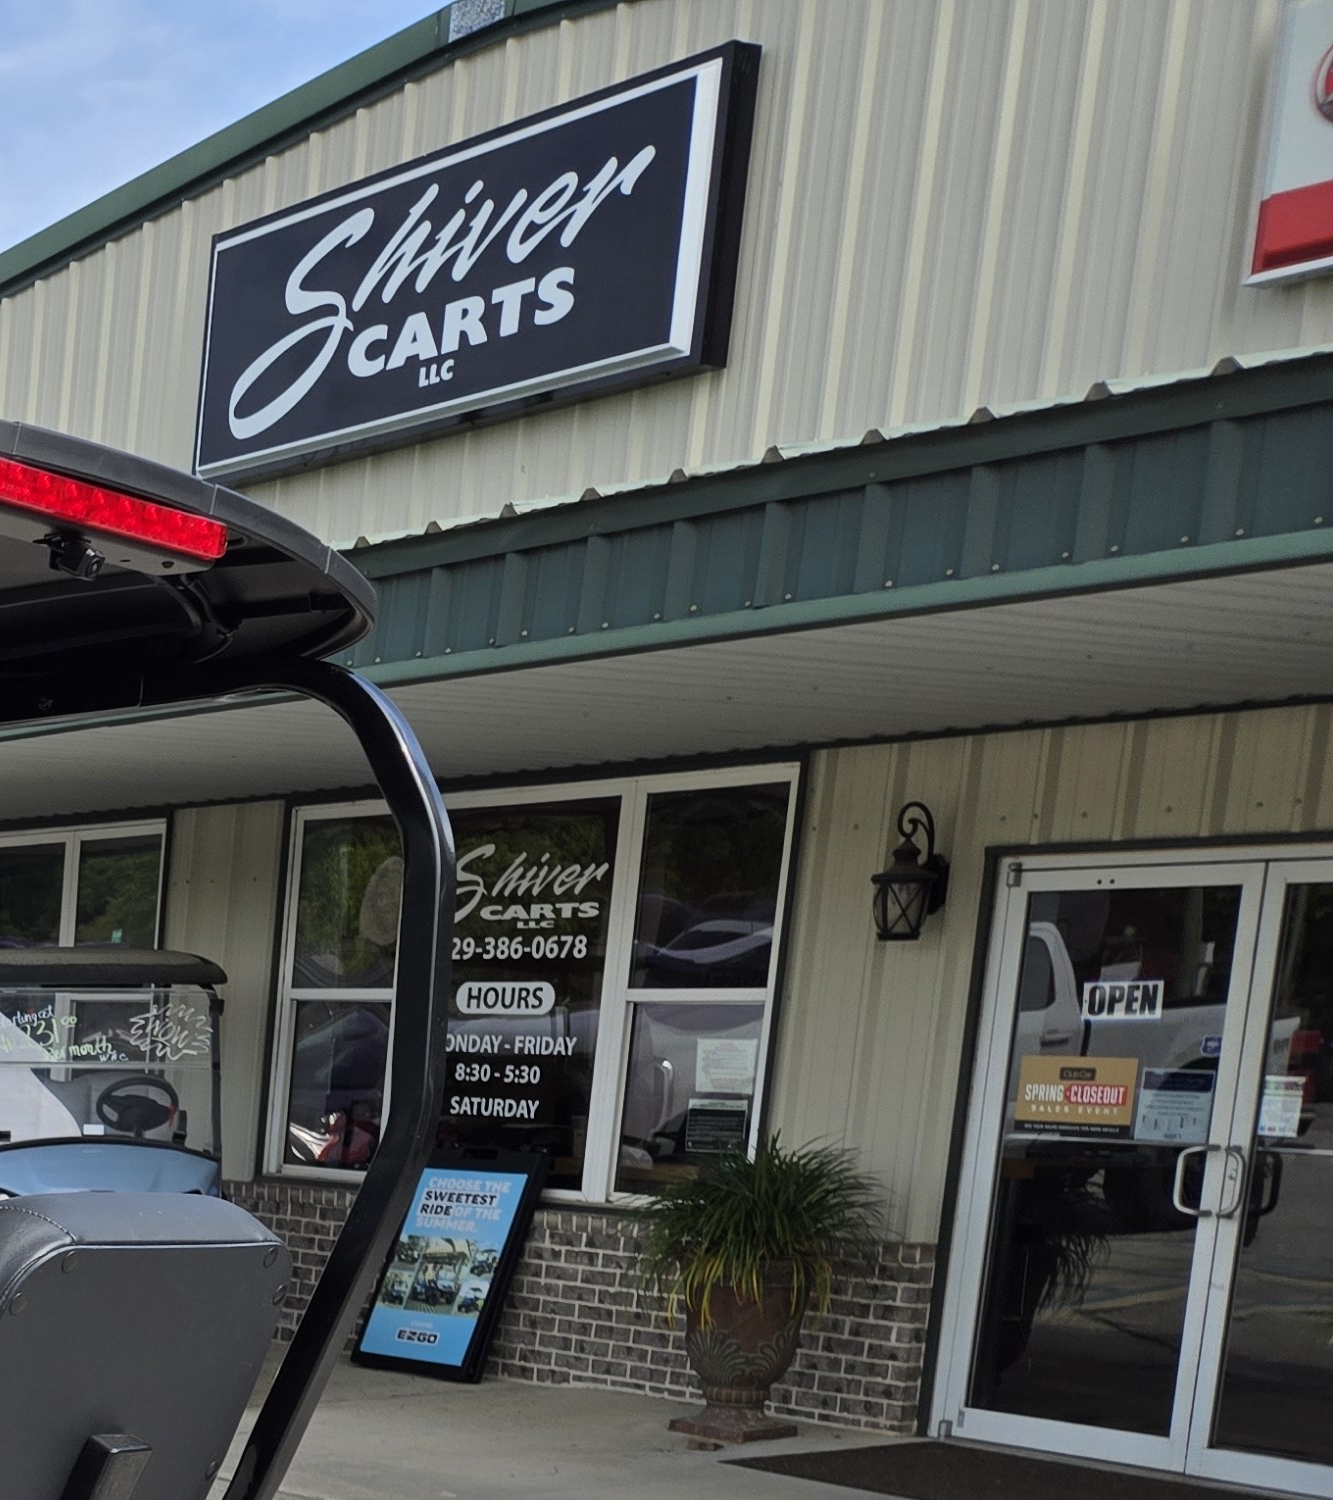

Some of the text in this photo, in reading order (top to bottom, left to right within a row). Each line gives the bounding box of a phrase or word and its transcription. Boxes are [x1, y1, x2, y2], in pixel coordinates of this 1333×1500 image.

[229, 145, 655, 439] Shiver
[347, 267, 575, 377] CARTS
[419, 359, 454, 387] LLC
[455, 843, 610, 924] Shiver
[480, 902, 600, 921] CARTS
[516, 920, 555, 929] LLC
[451, 934, 588, 960] 29-386-0678
[466, 986, 544, 1010] HOURS
[1088, 984, 1159, 1016] OPEN
[445, 1033, 502, 1054] ONDAY
[514, 1035, 577, 1056] FRIDAY
[455, 1063, 491, 1082] 8:30
[503, 1064, 541, 1084] 5:30
[1025, 1084, 1064, 1102] SPRING
[1070, 1085, 1125, 1105] CLOSEOUT
[450, 1096, 540, 1119] SATURDAY
[1031, 1104, 1119, 1115] SALES EVENT
[429, 1177, 511, 1193] CHOOSE THE
[424, 1190, 497, 1206] SWEETEST
[420, 1203, 502, 1220] RIDE OF THE
[397, 1329, 438, 1344] EZGO
